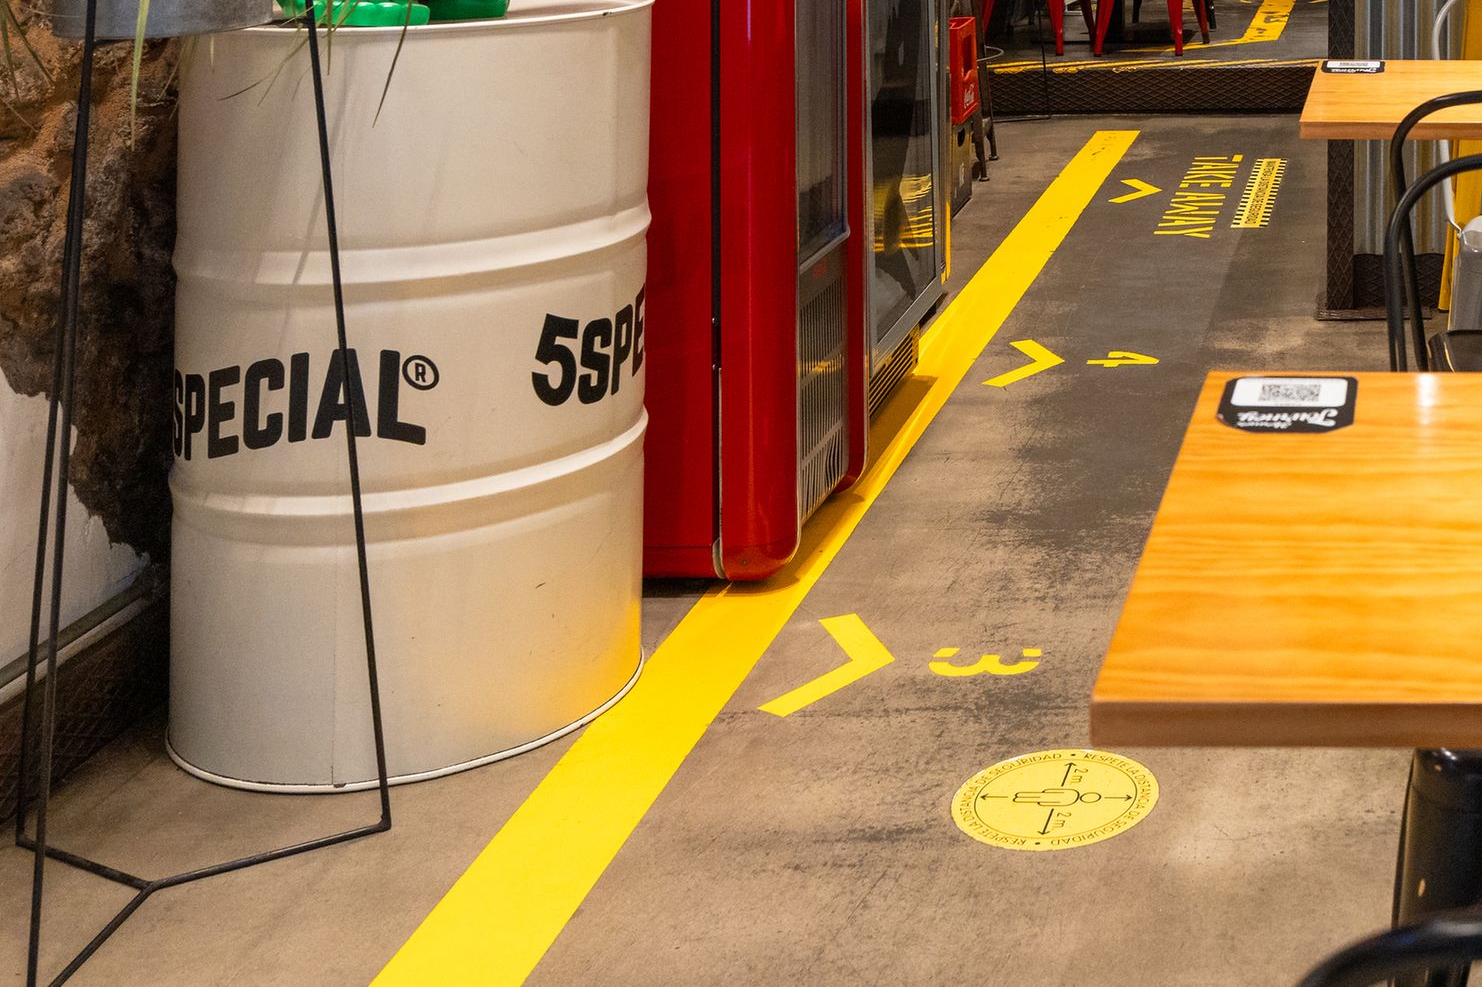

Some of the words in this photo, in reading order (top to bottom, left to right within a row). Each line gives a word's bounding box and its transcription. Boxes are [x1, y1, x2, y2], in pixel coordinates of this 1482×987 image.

[1179, 154, 1244, 188] TAKE
[1153, 191, 1227, 239] AWAY
[1086, 350, 1160, 368] 4
[928, 647, 1042, 676] 3
[989, 753, 1062, 776] SEGURIDAD
[1083, 753, 1130, 768] RESPETE
[1126, 766, 1139, 775] LA
[975, 775, 992, 785] DE
[1123, 810, 1140, 821] DE
[978, 829, 1027, 845] RESPETE
[1051, 820, 1127, 845] SEGURIDAD
